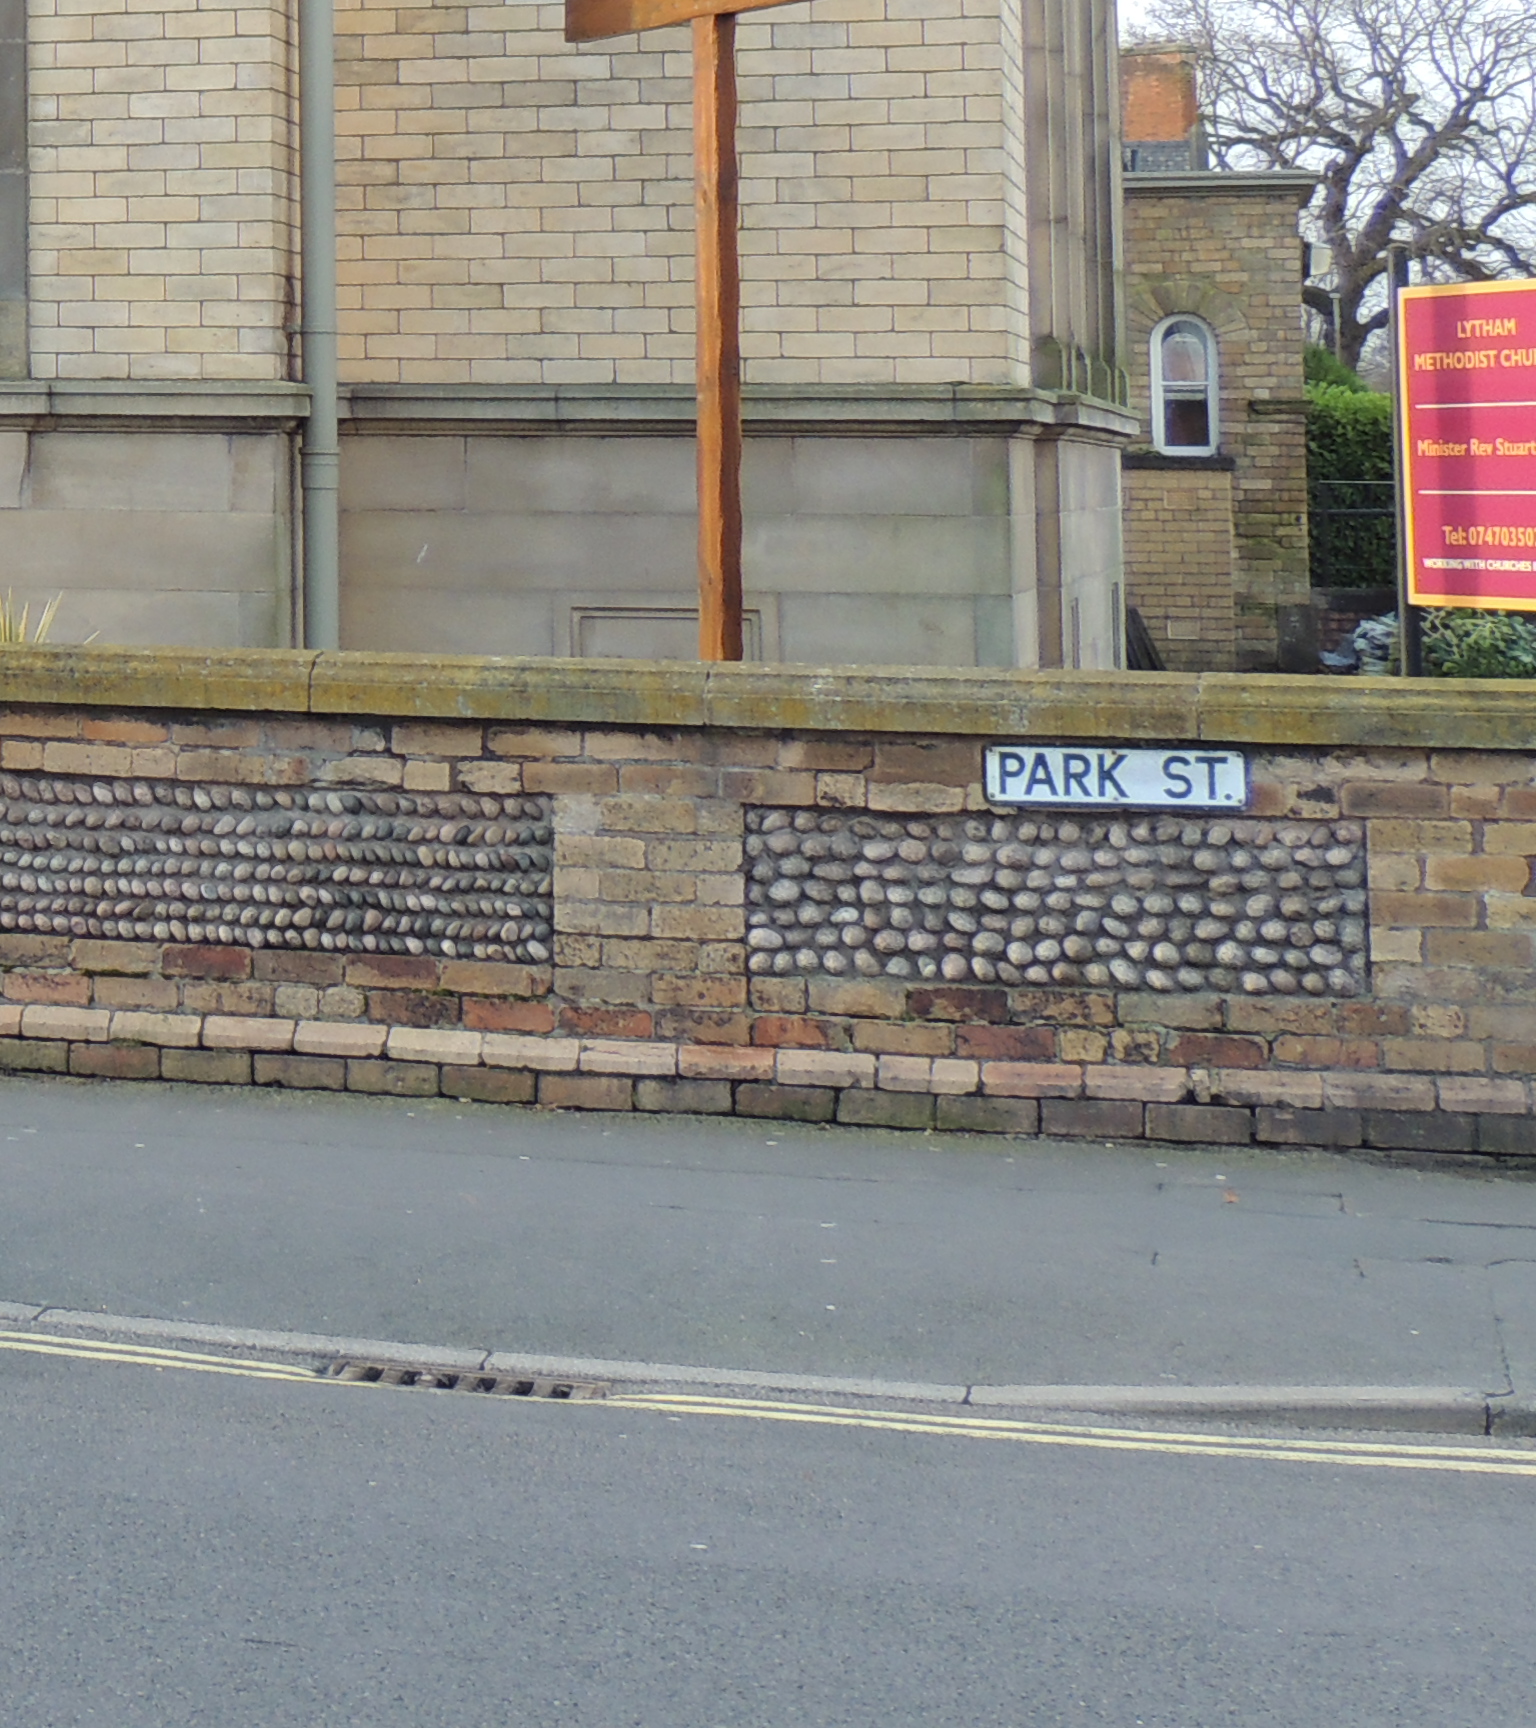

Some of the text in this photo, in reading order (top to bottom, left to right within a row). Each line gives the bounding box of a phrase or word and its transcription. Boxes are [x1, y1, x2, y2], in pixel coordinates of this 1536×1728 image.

[1456, 317, 1517, 339] LYTHAM
[1414, 349, 1498, 372] METHODIST
[1417, 437, 1536, 457] Minister Rev Stuart
[1441, 525, 1467, 545] Tel:
[1422, 558, 1463, 570] WORKING
[1463, 558, 1486, 571] WITH
[1486, 559, 1532, 572] CHURCHES
[998, 751, 1234, 801] PARK ST.
